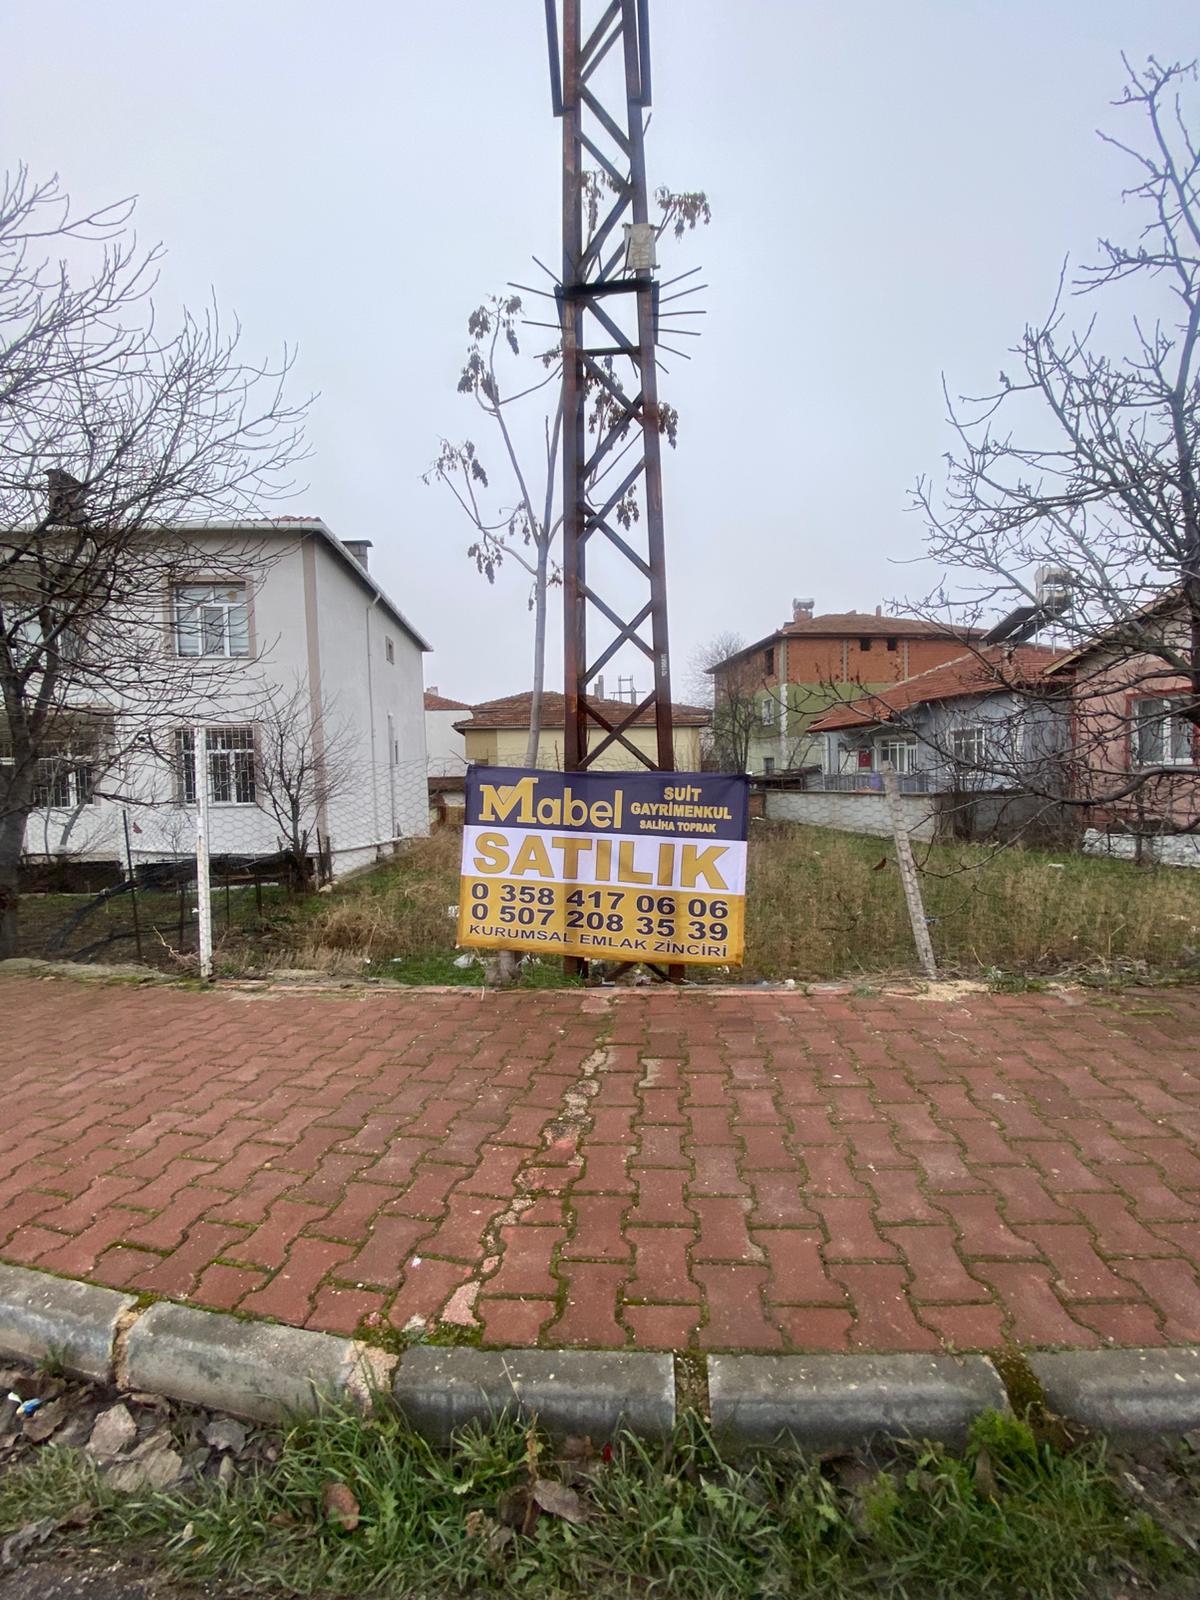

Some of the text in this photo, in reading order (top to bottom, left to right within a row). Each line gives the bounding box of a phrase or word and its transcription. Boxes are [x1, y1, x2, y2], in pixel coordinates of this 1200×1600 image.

[479, 777, 623, 829] Mabel
[664, 785, 701, 801] SUİT
[631, 801, 732, 820] GAYRİMENKUL
[640, 819, 716, 832] SALİHA TOPRAK
[473, 832, 730, 890] SATILIK
[471, 883, 728, 918] 0 358 417 06 06
[472, 904, 728, 941] 0 507 208 35 39
[469, 924, 727, 957] KURUMSAL EMLAK ZİNCİRİ
